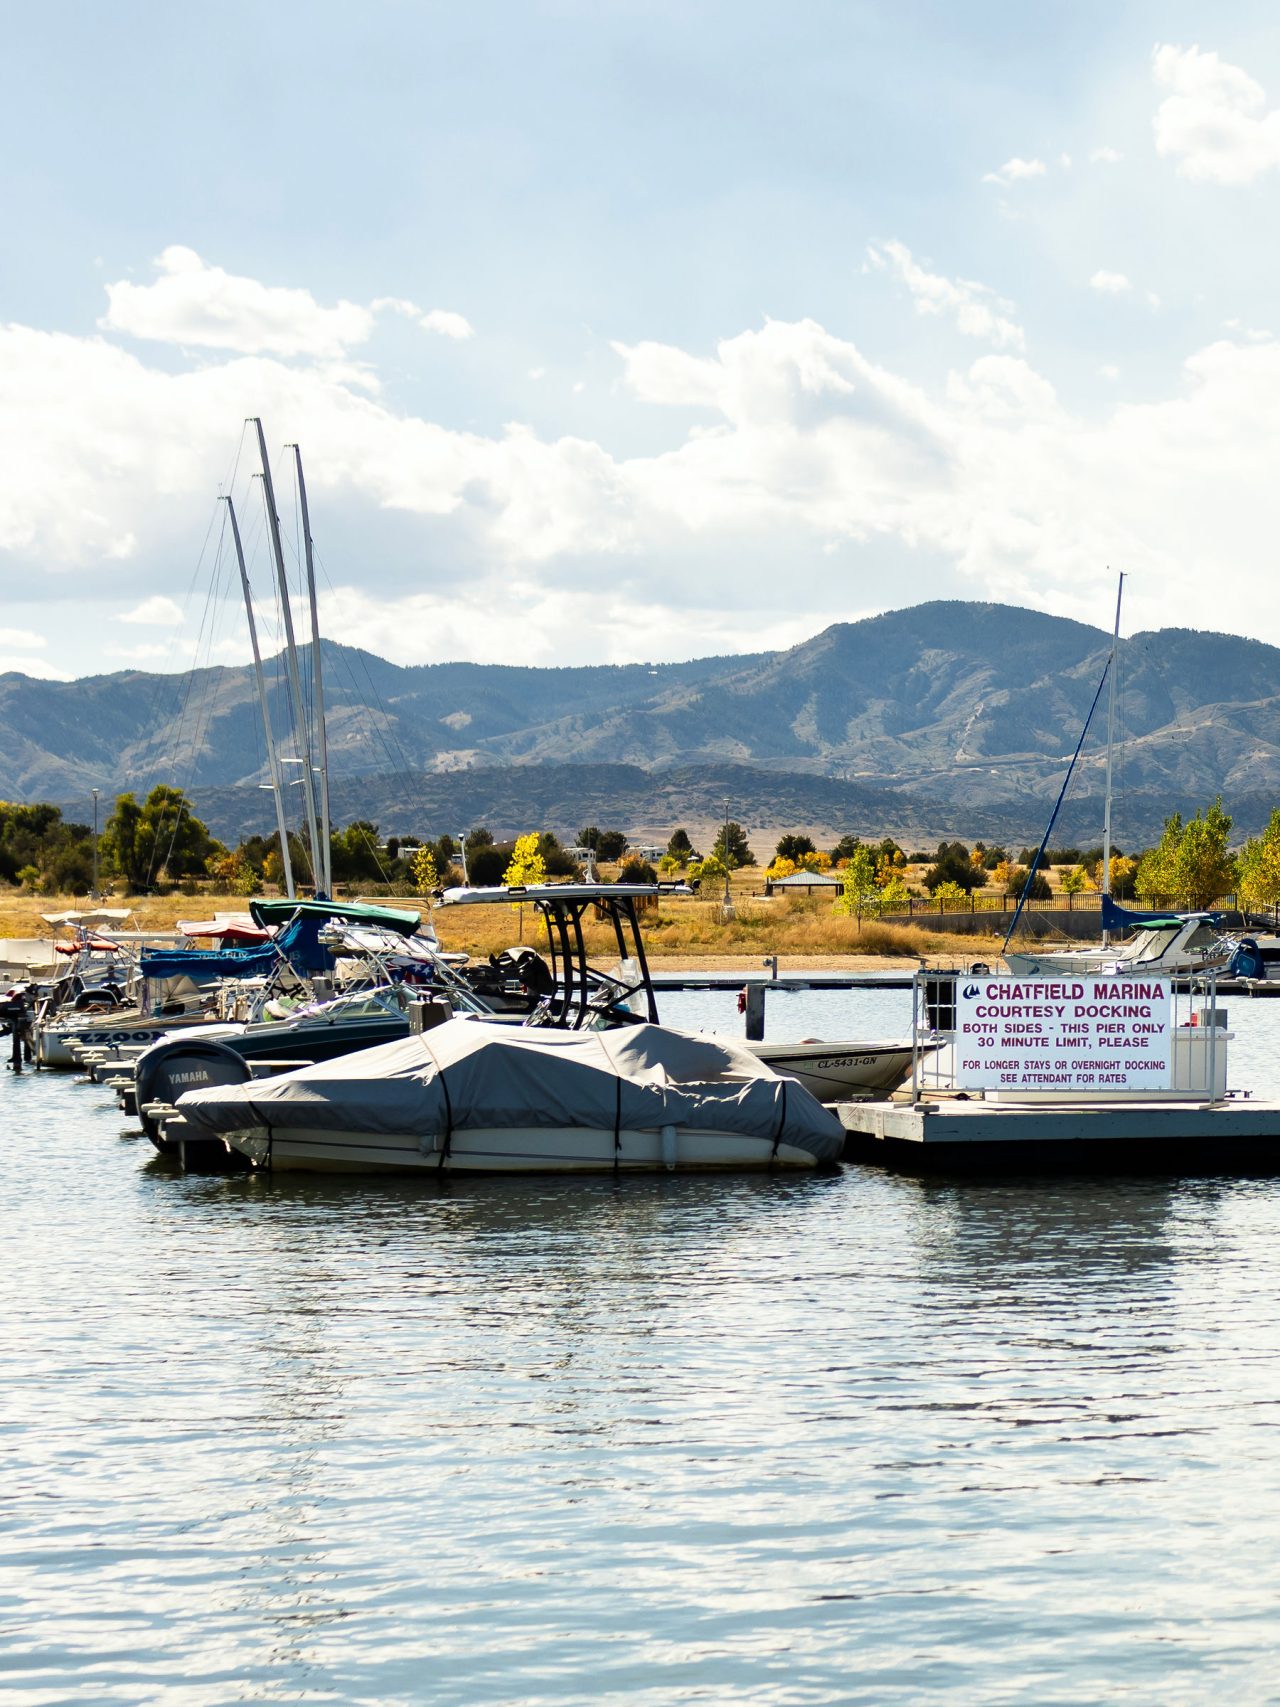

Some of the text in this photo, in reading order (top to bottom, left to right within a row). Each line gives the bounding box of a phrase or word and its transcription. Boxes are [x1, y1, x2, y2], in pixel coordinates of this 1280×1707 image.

[985, 983, 1165, 1001] CHATFIELD MARINA
[975, 1005, 1152, 1018] COURTESY DOCKING
[962, 1022, 998, 1034] BOTH
[1004, 1022, 1043, 1034] SIDES
[1060, 1022, 1090, 1034] THIS
[1096, 1023, 1126, 1034] PIER
[1131, 1022, 1166, 1034] ONLY
[977, 1036, 1149, 1050] 30 MINUTE LIMIT, PLEASE
[962, 1060, 1166, 1070] FOR LONGER STAYS OR OVERNIGHT DOCKING
[168, 1070, 209, 1084] YAMAHA
[1000, 1073, 1127, 1083] SEE ATTENDANT FOR RATES
